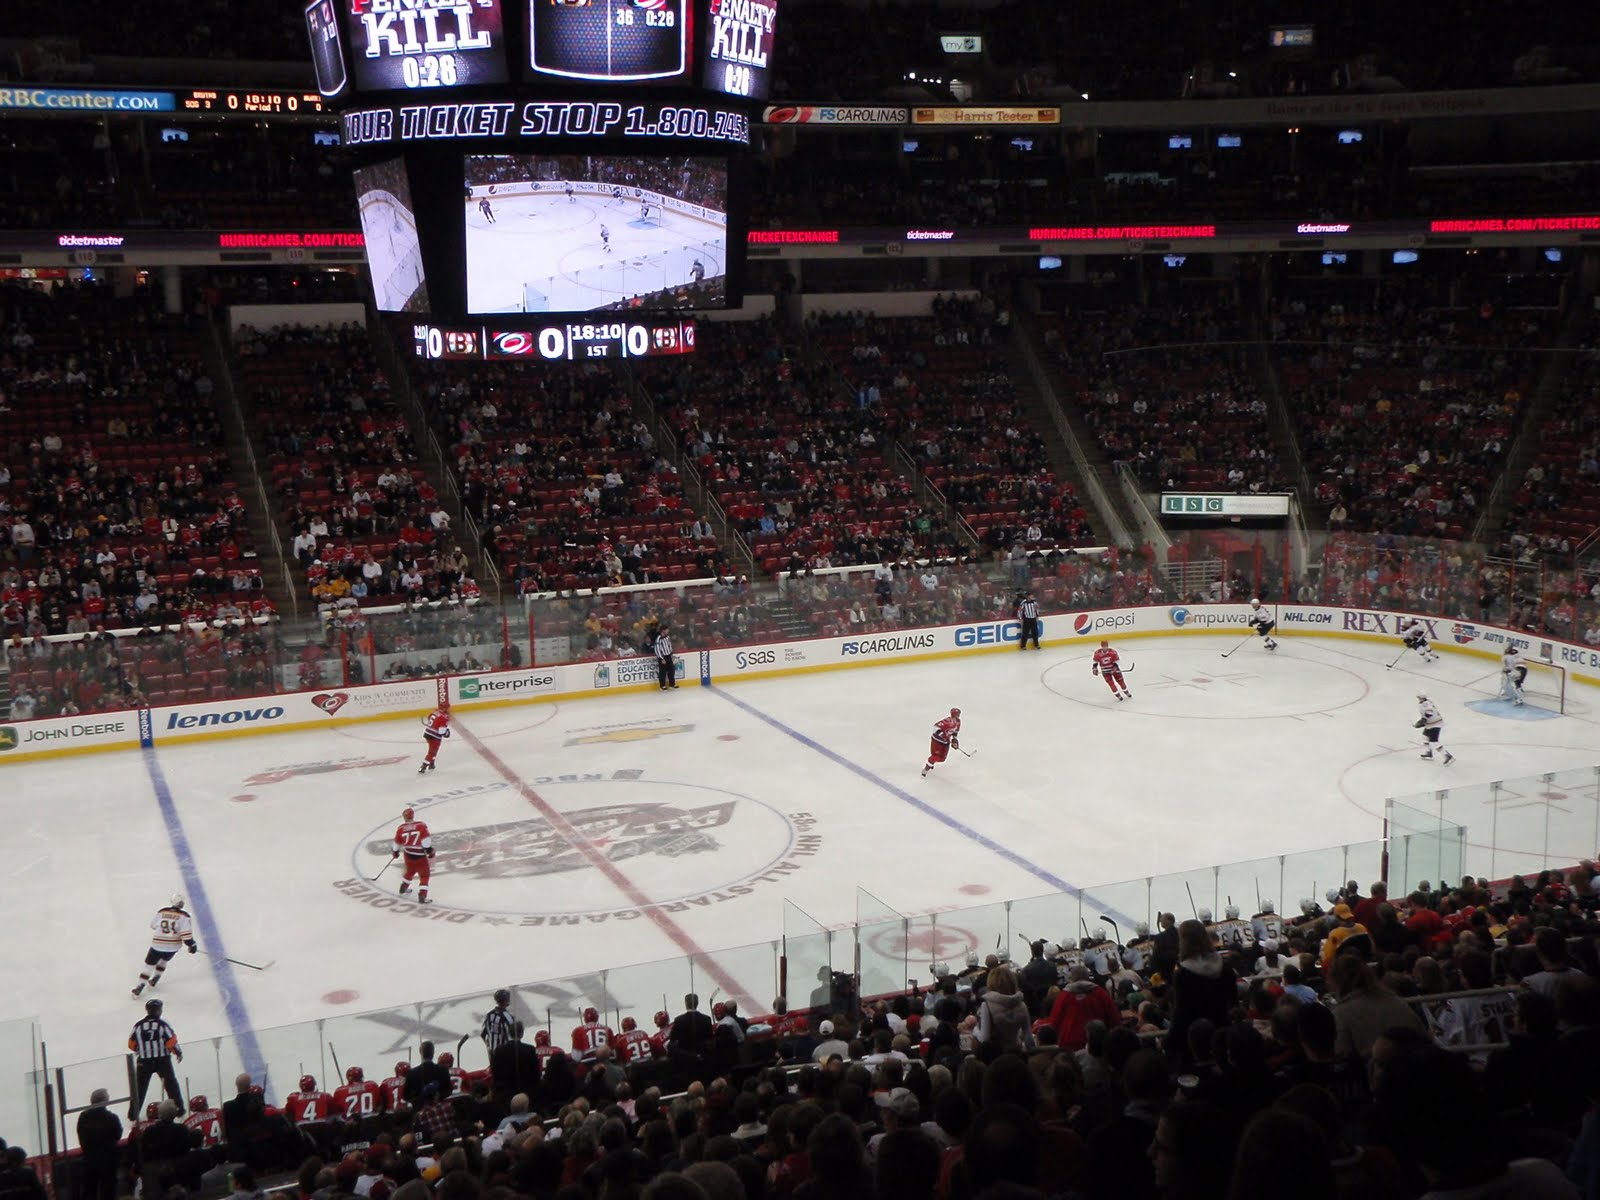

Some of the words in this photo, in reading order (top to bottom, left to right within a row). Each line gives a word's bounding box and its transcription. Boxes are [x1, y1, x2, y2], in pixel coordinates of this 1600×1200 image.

[616, 9, 634, 26] 36
[646, 10, 675, 27] 0:28
[361, 5, 491, 58] KILL
[711, 15, 767, 68] KILL
[402, 55, 457, 88] 0:28
[228, 95, 238, 109] 0
[288, 97, 298, 111] 0
[401, 103, 515, 138] TICKET
[520, 102, 622, 136] STOP
[954, 110, 993, 122] Harris
[995, 110, 1034, 122] Teeter
[906, 230, 954, 240] ticketmaster
[1297, 223, 1350, 234] ticketmaster
[59, 235, 124, 247] ticketmaster
[572, 324, 622, 340] 18:10
[627, 325, 648, 356] 0
[428, 327, 442, 358] 0
[538, 328, 564, 358] 0
[587, 346, 608, 357] 1ST
[1095, 612, 1135, 631] pepsi
[1284, 612, 1332, 624] NHL.COM
[1343, 611, 1390, 634] REX
[1484, 632, 1504, 644] AUTO
[617, 659, 635, 667] NORTH
[701, 650, 709, 678] Reebok
[748, 650, 776, 665] sas
[1561, 647, 1587, 665] RBC
[438, 677, 447, 704] Reebo
[463, 673, 554, 695] enterprise
[141, 709, 150, 740] Reebok
[167, 705, 285, 730] lenovo
[24, 727, 69, 743] JOHN
[72, 722, 125, 737] DEERE
[402, 831, 421, 845] 77
[586, 1029, 607, 1049] 16
[627, 1040, 652, 1061] 39
[303, 1100, 317, 1121] 4
